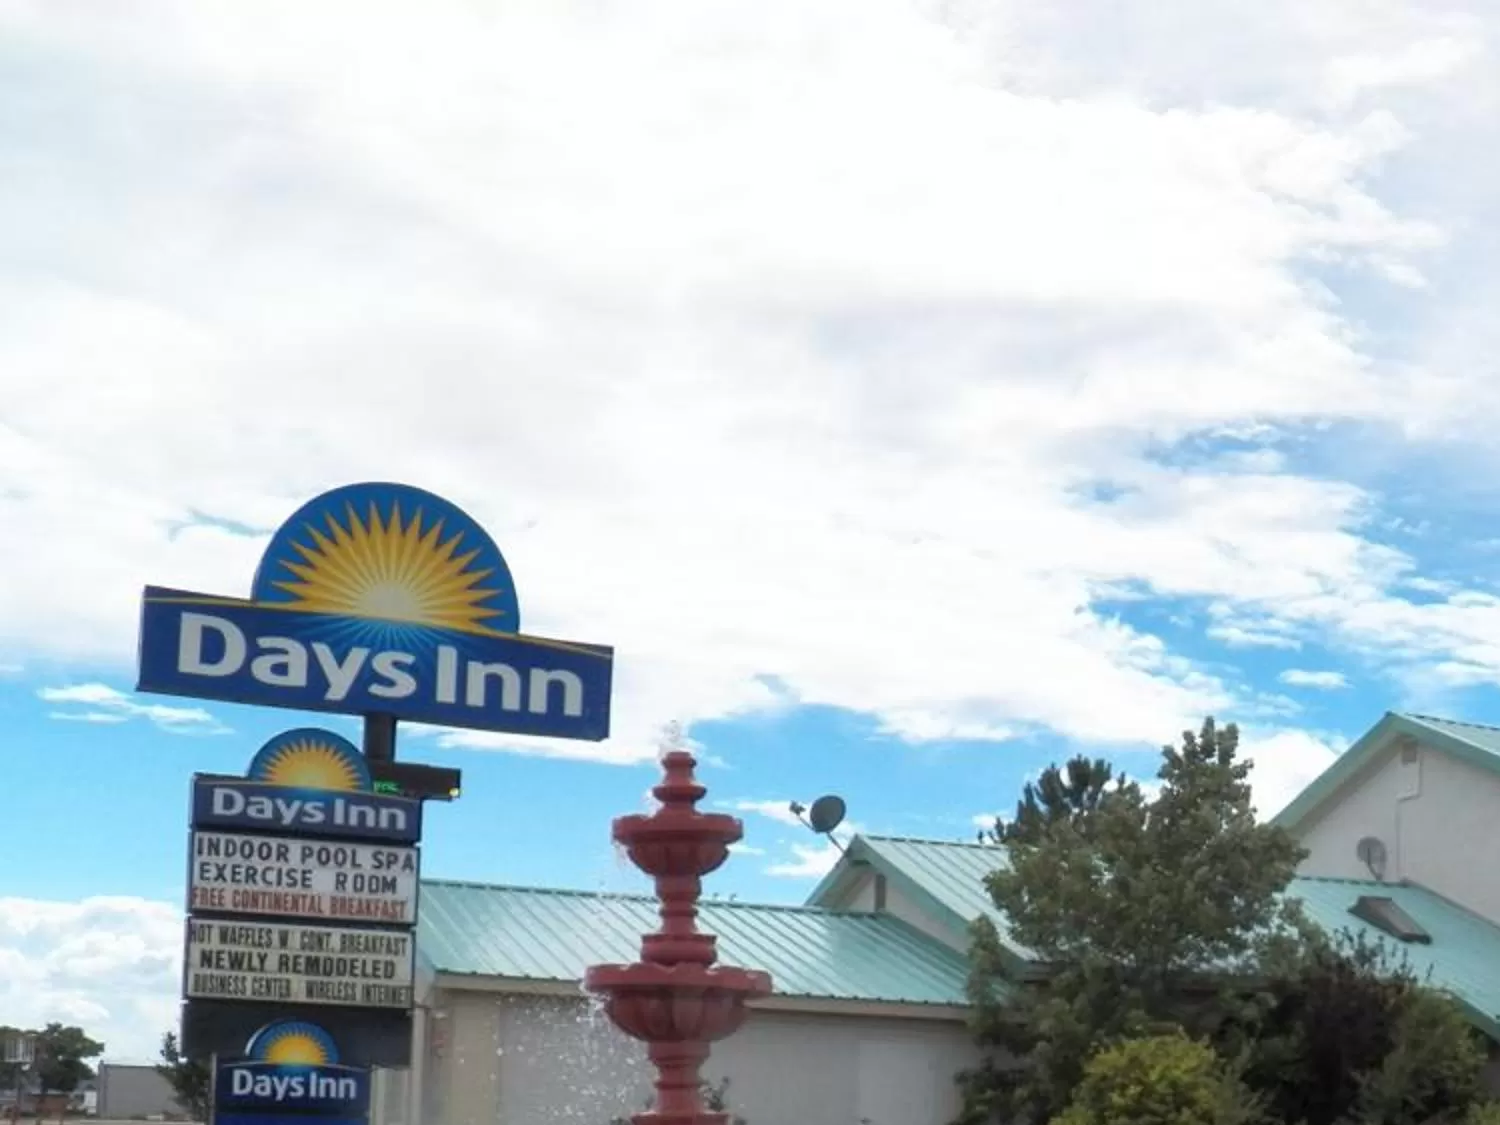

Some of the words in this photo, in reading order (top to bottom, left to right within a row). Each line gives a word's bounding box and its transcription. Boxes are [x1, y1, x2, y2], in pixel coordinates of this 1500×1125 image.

[176, 611, 417, 701] Days
[435, 645, 584, 718] Inn
[212, 787, 326, 826] Days
[333, 797, 407, 831] Inn
[197, 836, 290, 864] INDOOR
[300, 845, 363, 869] POOL
[371, 850, 415, 873] SPA
[199, 861, 313, 889] EXERCISE
[334, 871, 398, 895] ROOM
[192, 886, 226, 908] FREE
[231, 889, 323, 914] CONTINENTAL
[330, 895, 408, 920] BREAKFAST
[218, 924, 273, 950] WAFFLES
[340, 932, 407, 957] BREAKFAST
[200, 948, 269, 973] NEWLY
[278, 952, 396, 979] REMODELED
[193, 973, 247, 996] BUSINESS
[251, 975, 291, 999] CENTER
[306, 979, 357, 1002] WIRELESS
[361, 983, 414, 1007] INTERNET
[232, 1068, 304, 1101] Days
[309, 1071, 357, 1100] Inn
